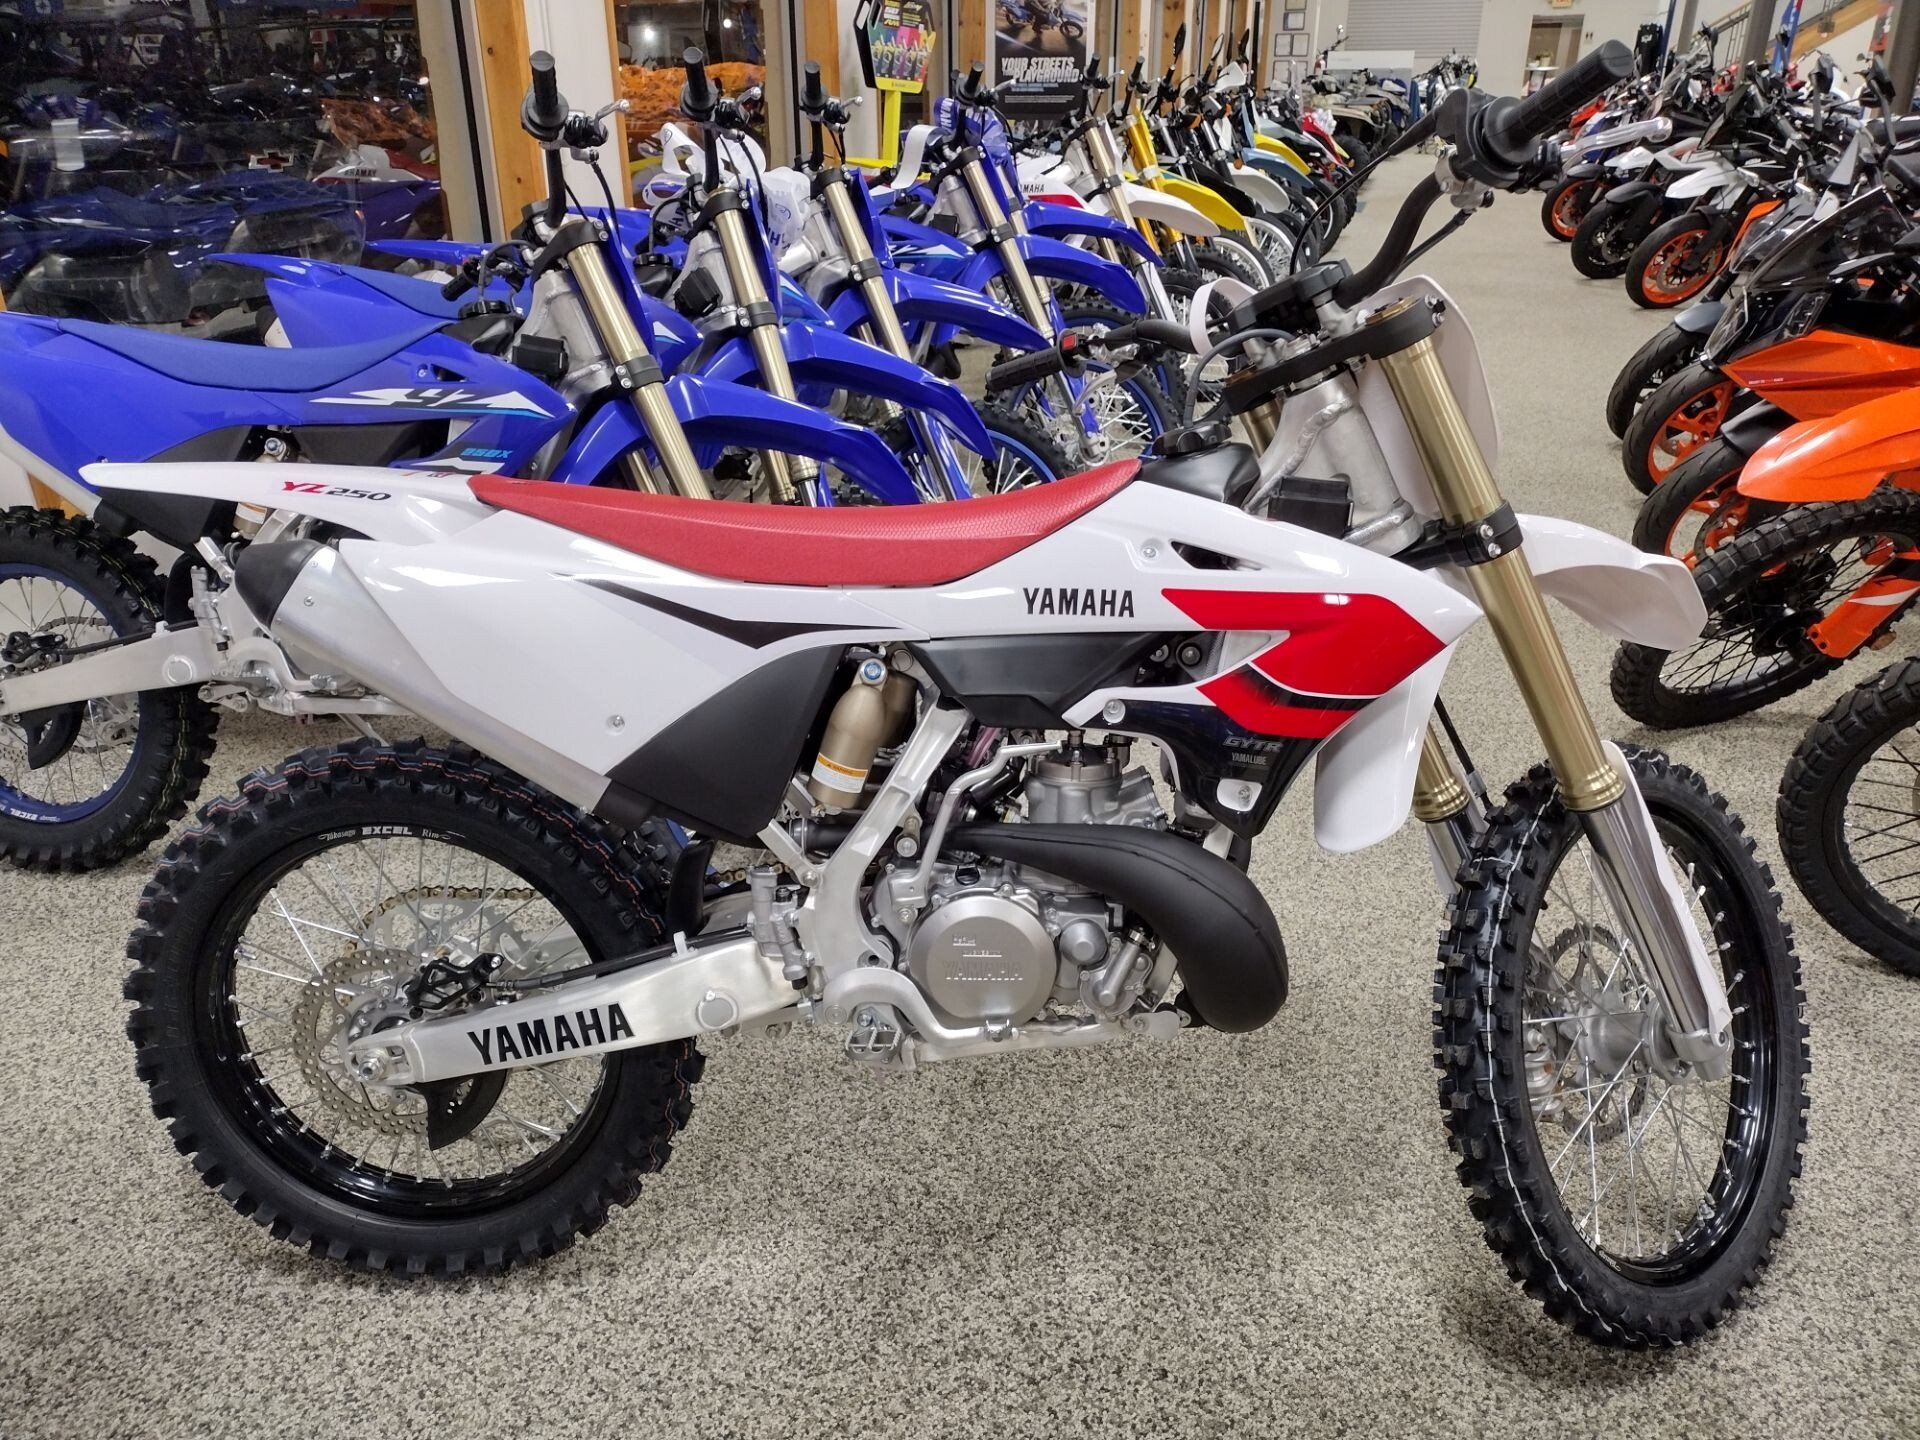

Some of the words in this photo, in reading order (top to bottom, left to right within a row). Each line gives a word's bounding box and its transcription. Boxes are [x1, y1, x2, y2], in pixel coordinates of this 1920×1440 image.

[1001, 57, 1028, 71] YOUR
[1029, 57, 1075, 71] STREETS
[1023, 587, 1135, 618] YAMAHA
[1222, 736, 1284, 752] GYTR
[1231, 752, 1267, 766] YAMALUBE
[361, 826, 413, 836] EXCEL
[422, 829, 439, 839] Rim
[467, 1001, 636, 1065] YAMAHA
